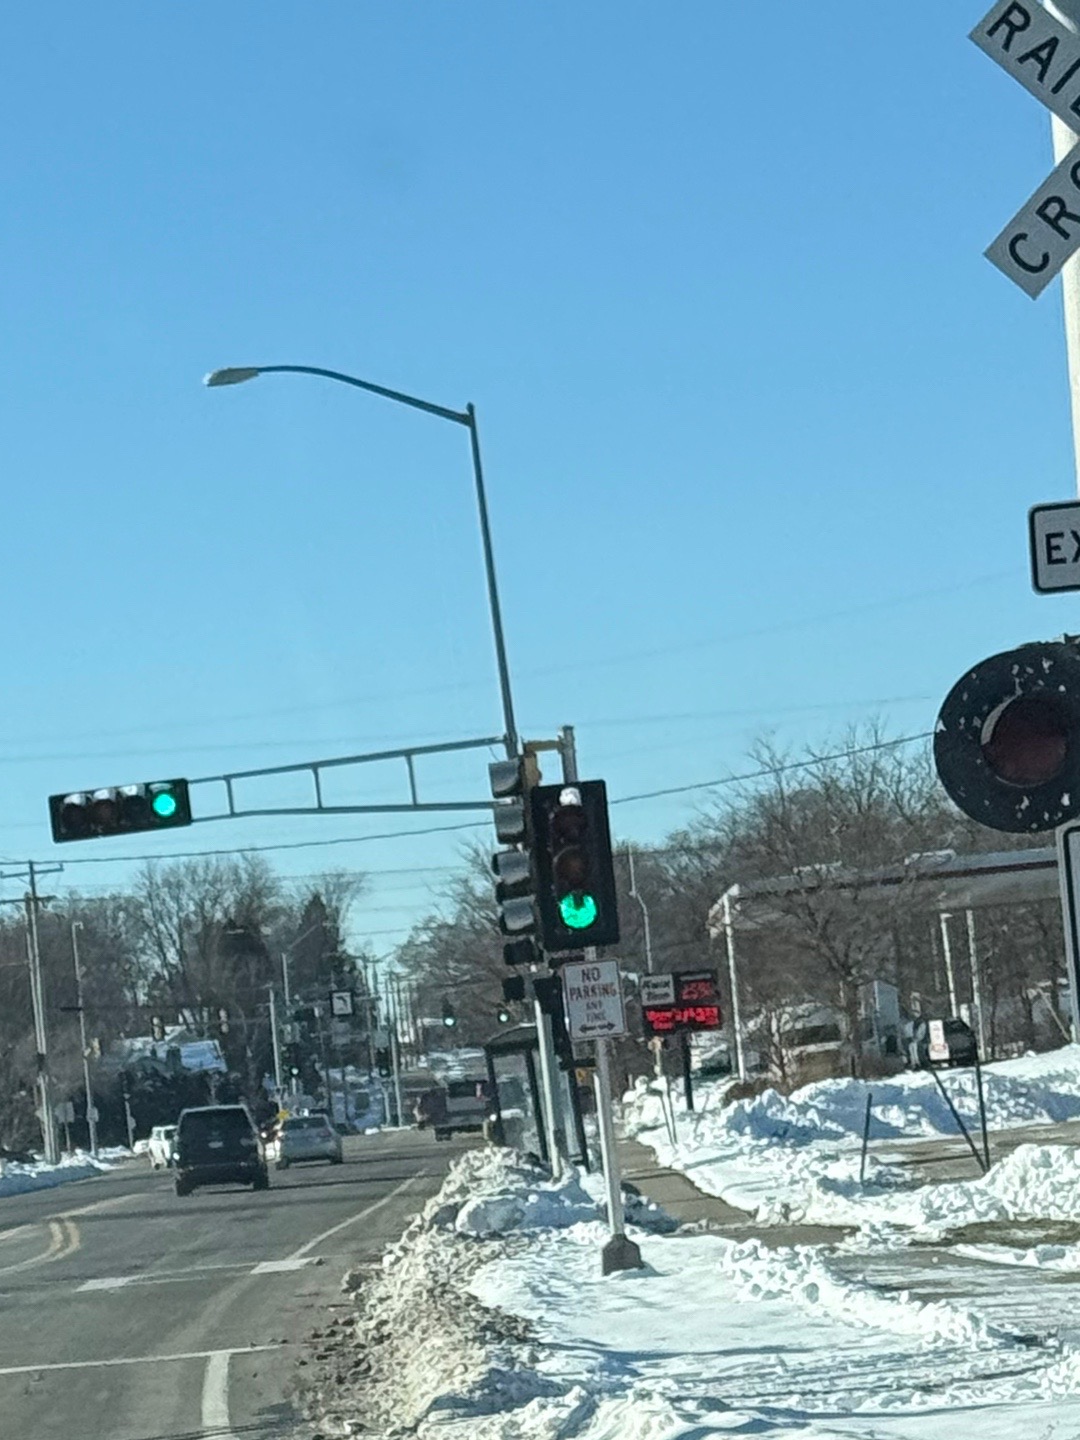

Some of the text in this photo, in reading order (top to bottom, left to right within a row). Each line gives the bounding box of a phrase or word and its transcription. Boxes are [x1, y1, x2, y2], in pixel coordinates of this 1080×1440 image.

[986, 0, 1080, 118] RAI
[1009, 160, 1080, 273] CR
[569, 983, 617, 1001] PARKING
[581, 967, 601, 983] NO
